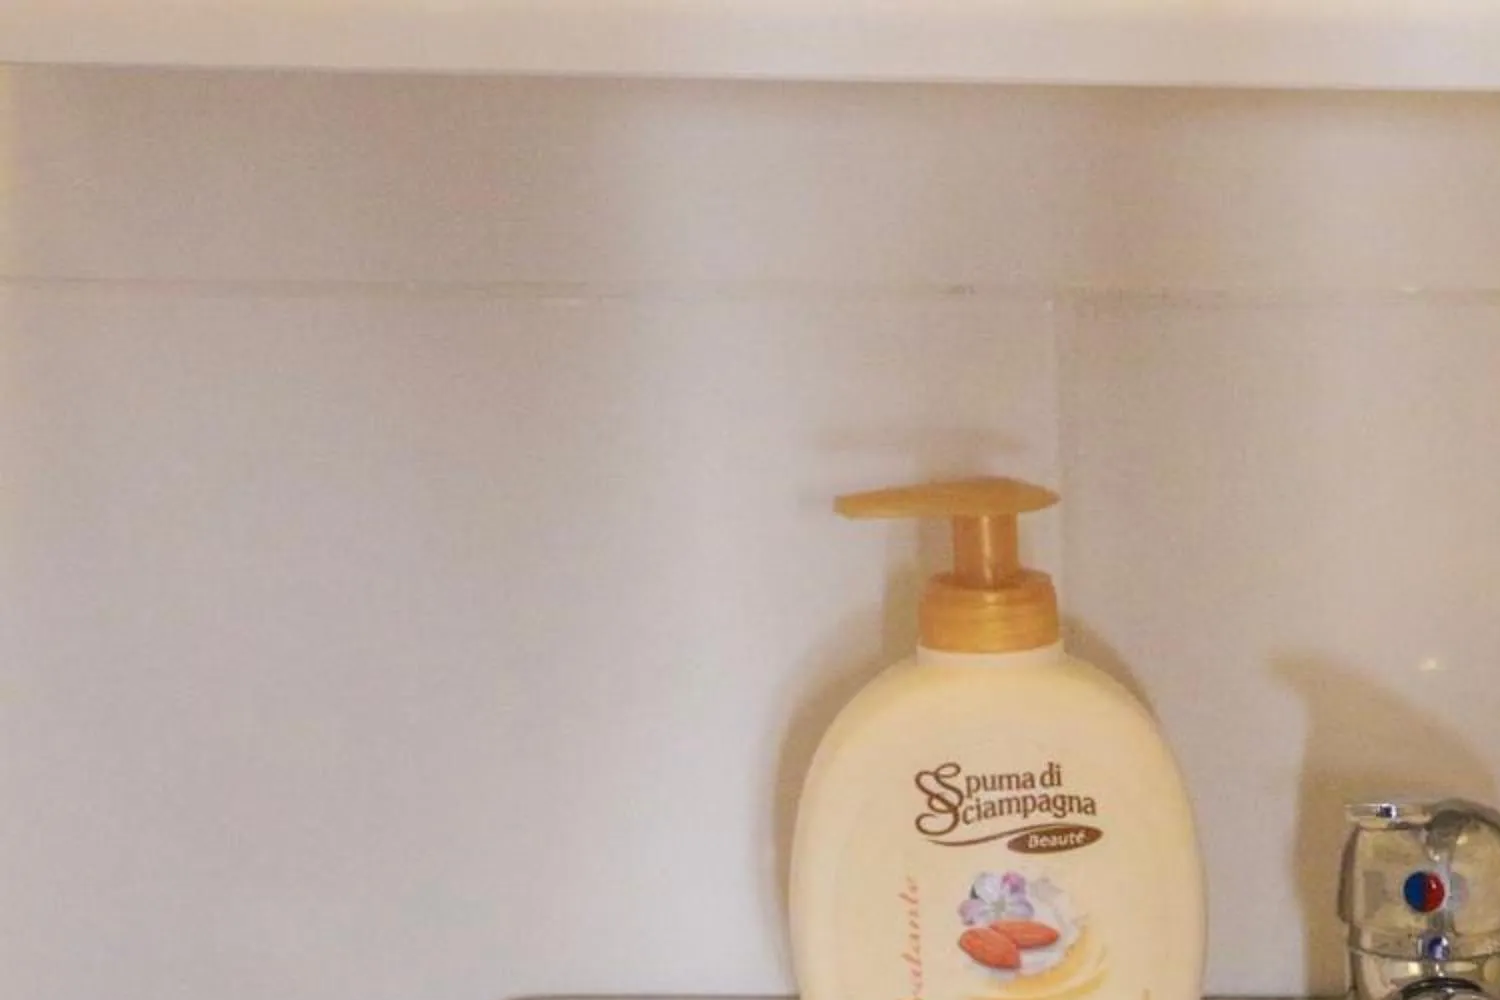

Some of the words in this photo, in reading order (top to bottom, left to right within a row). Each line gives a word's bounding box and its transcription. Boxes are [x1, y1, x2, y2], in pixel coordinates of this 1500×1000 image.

[914, 771, 1097, 836] Sciampagna
[924, 762, 1036, 812] Spuma
[1040, 761, 1062, 788] di
[1027, 831, 1088, 849] Beauté
